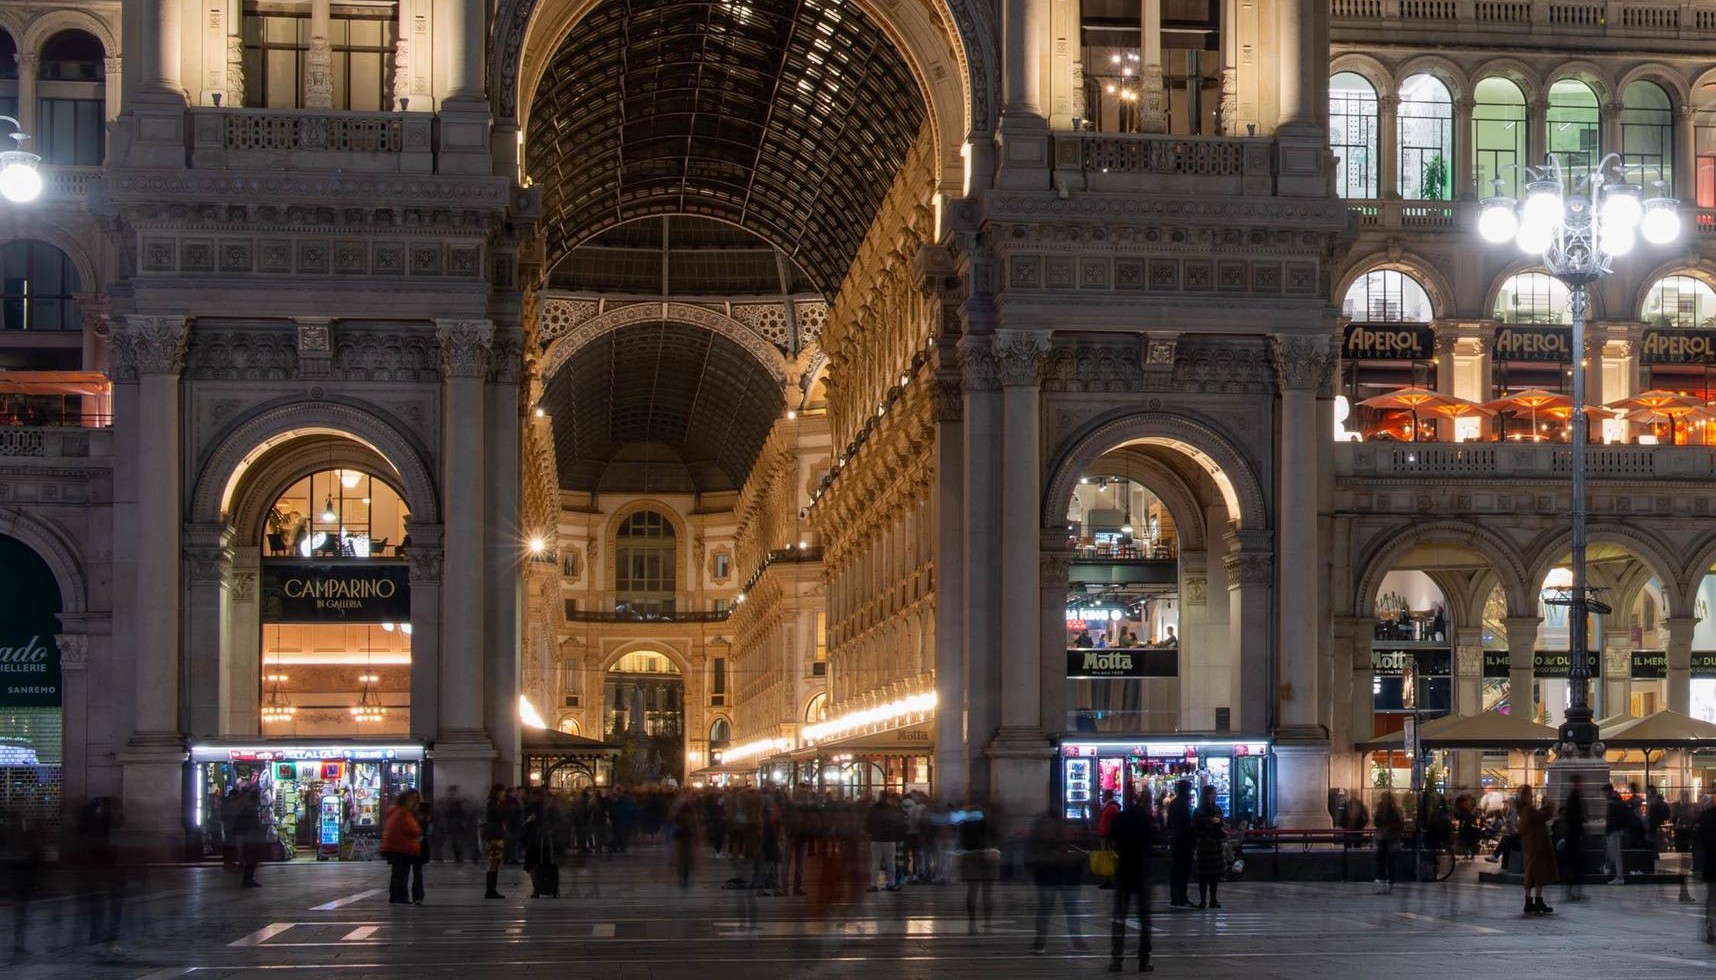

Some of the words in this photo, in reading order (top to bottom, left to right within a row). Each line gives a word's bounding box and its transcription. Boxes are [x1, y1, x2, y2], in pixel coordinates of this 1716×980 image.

[1348, 327, 1423, 351] APEROL
[1496, 328, 1570, 352] APEROL
[1643, 331, 1715, 355] APEROL
[284, 578, 396, 598] CAMPARINO
[316, 599, 325, 609] IN
[326, 599, 363, 610] GALLERIA
[1082, 651, 1134, 670] Motta
[1634, 657, 1643, 666] IL
[7, 686, 56, 694] SANREMO
